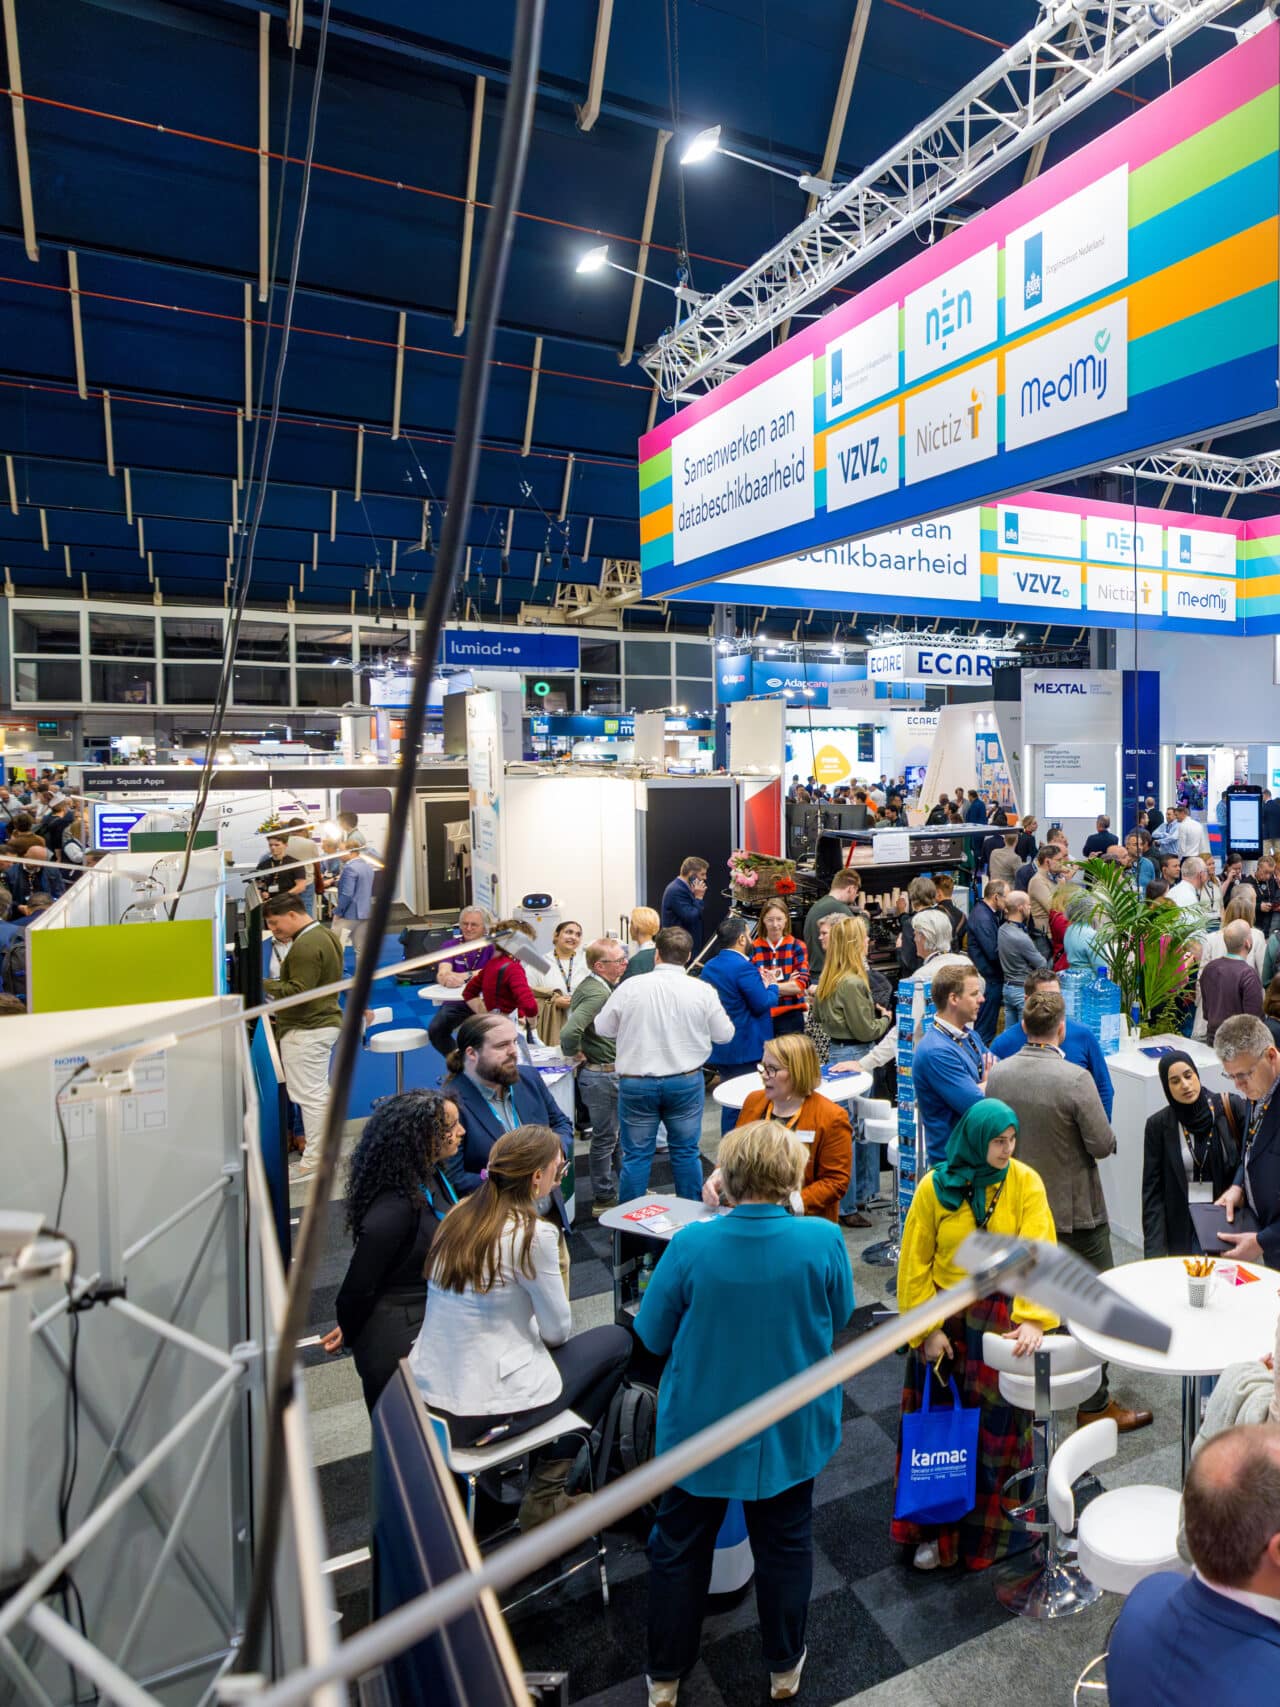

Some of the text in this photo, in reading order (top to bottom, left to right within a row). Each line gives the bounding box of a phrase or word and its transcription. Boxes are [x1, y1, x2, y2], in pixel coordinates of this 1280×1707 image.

[916, 413, 962, 456] Nictiz
[684, 409, 795, 486] Samenwerken aan
[840, 436, 880, 484] VZVZ
[678, 446, 805, 532] databeschikbaarheid
[911, 521, 952, 540] aan
[1017, 571, 1062, 595] VZVZ
[1097, 583, 1137, 602] Nictiz
[451, 641, 501, 655] lumiad
[871, 653, 902, 673] ECARE
[917, 651, 998, 677] ECAR
[1034, 683, 1087, 695] MEXTAL
[116, 778, 142, 787] Squad
[143, 777, 165, 786] Apps
[911, 1448, 968, 1467] karmac
